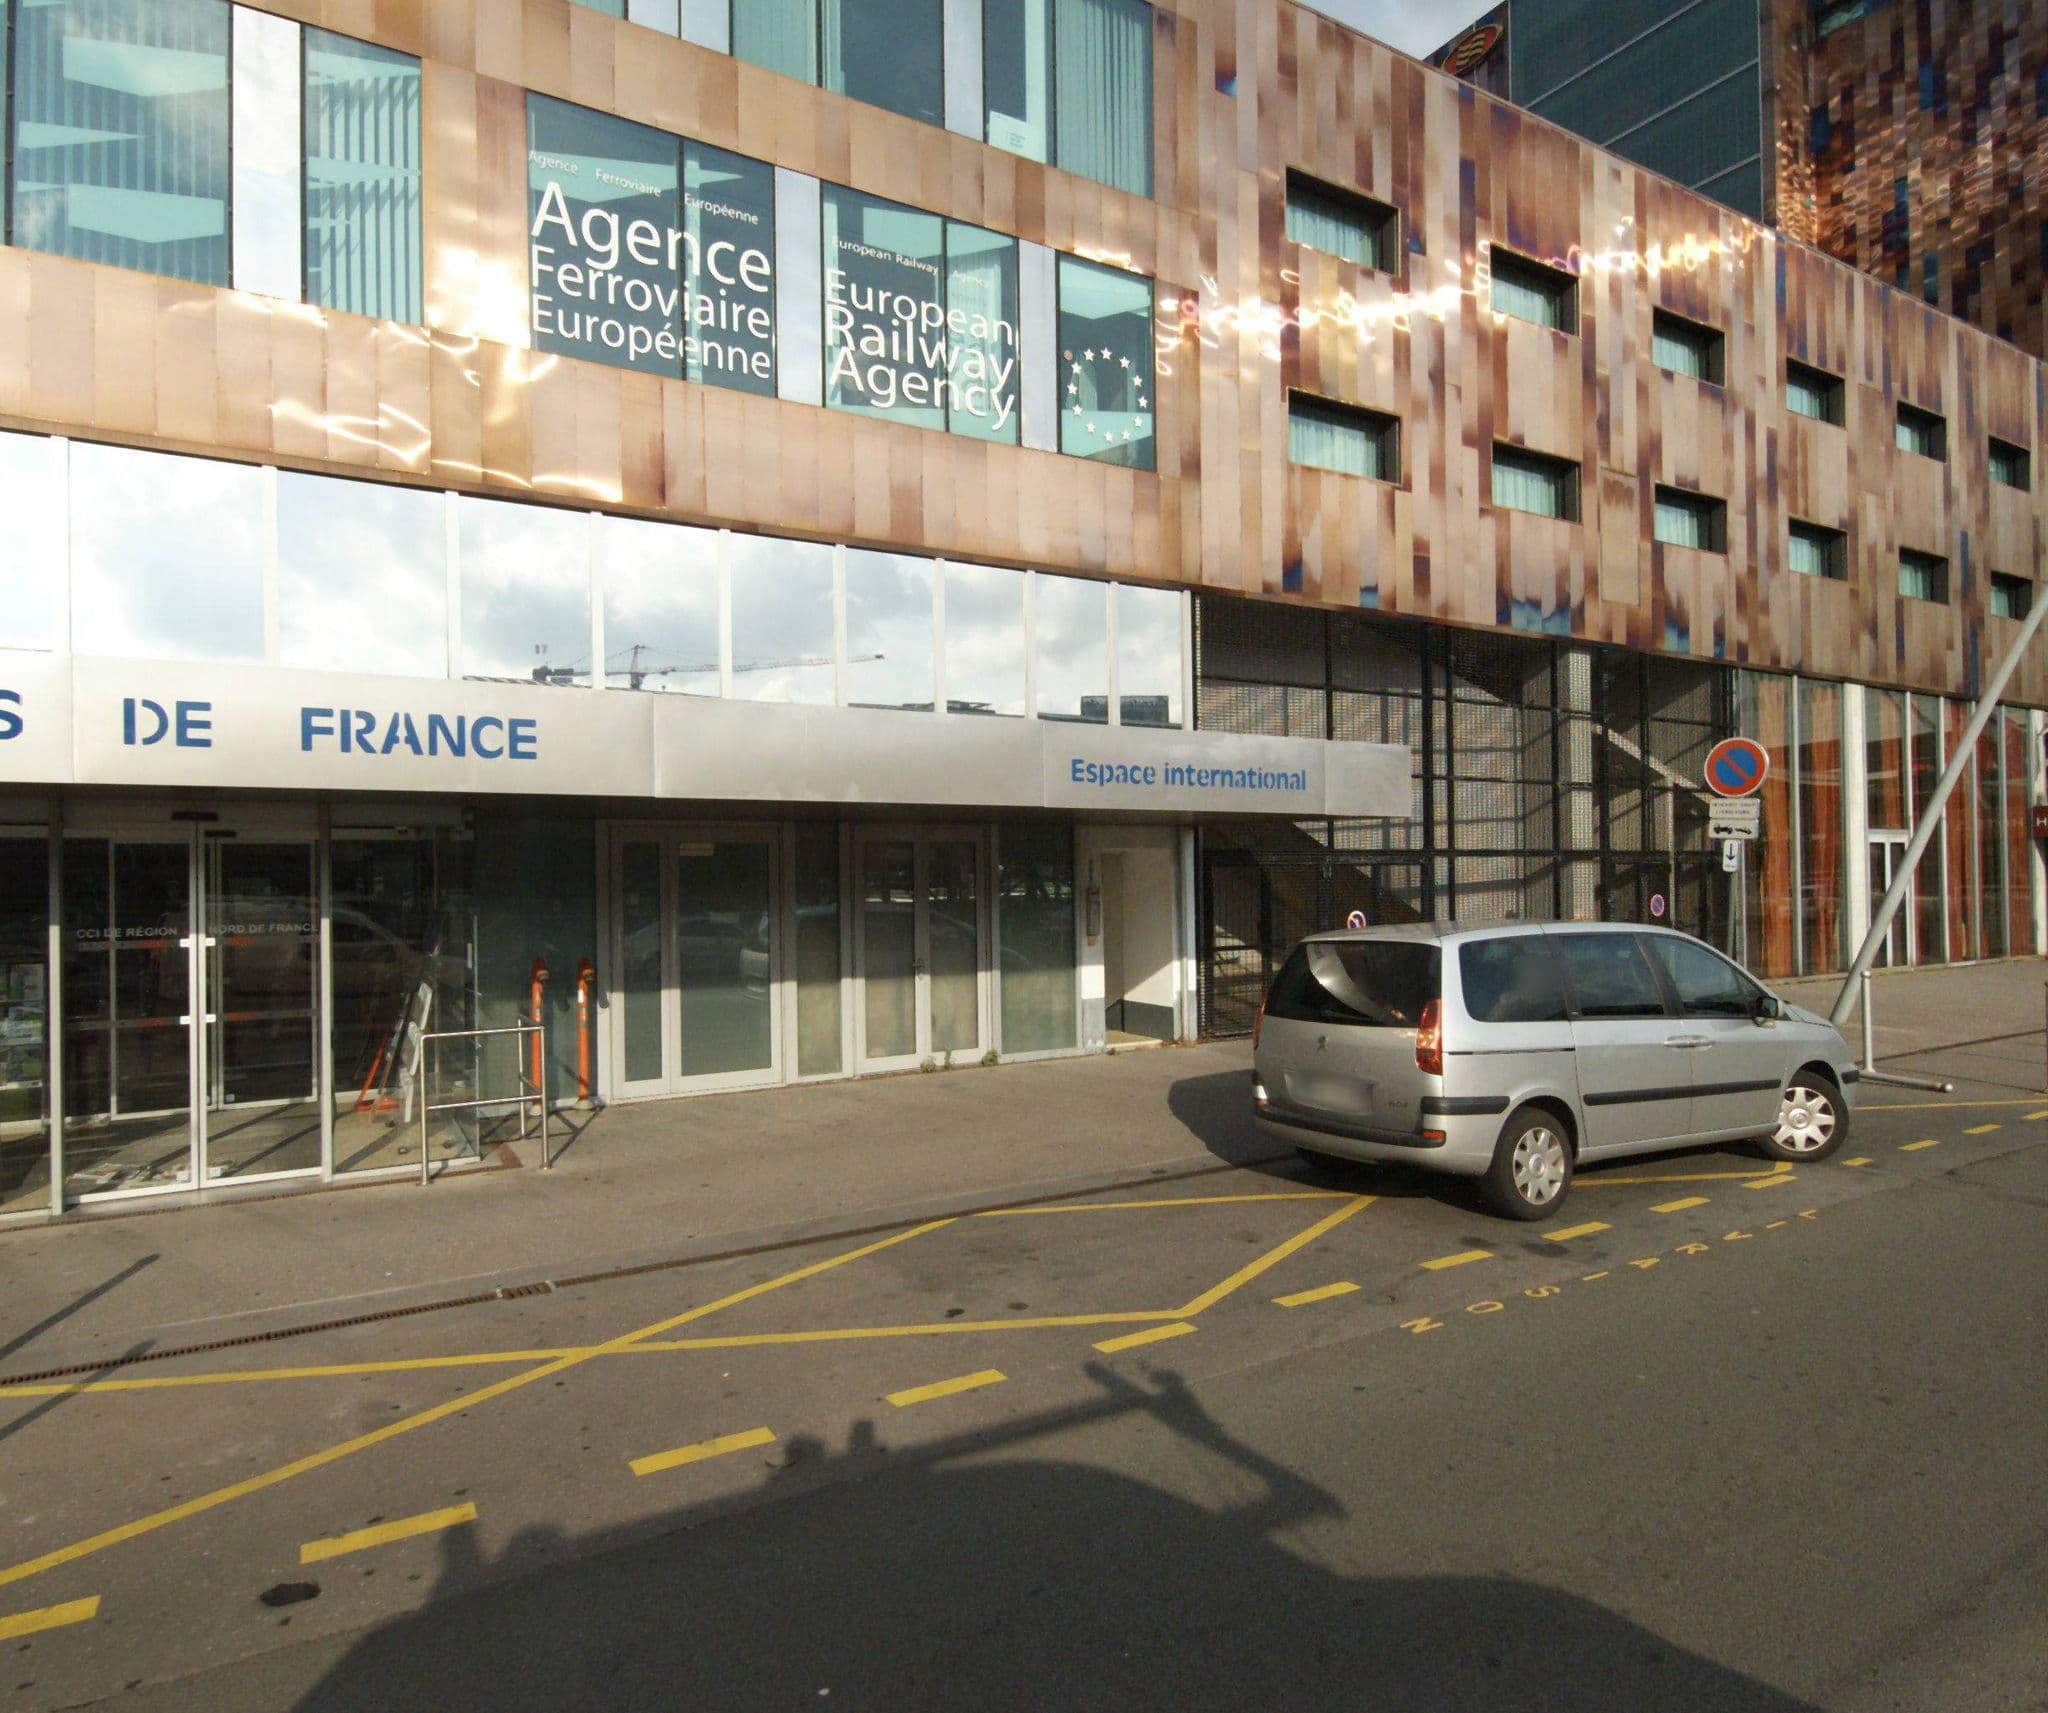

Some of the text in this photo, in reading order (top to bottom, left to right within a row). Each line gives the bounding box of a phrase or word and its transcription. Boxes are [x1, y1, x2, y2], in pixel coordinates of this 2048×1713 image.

[528, 151, 759, 225] Agence Ferroviaire Européenne
[531, 181, 771, 293] Agence
[832, 235, 892, 261] European
[896, 254, 939, 276] Railway
[532, 244, 771, 339] Ferroviaire
[827, 268, 1013, 346] European
[532, 294, 771, 379] Européenne
[827, 304, 1014, 394] Railway
[829, 346, 1015, 431] Agency
[122, 698, 213, 748] DE
[300, 707, 538, 760] FRANCE
[1071, 758, 1307, 791] Espace international
[76, 928, 100, 939] CCI
[126, 925, 178, 938] RÉGION
